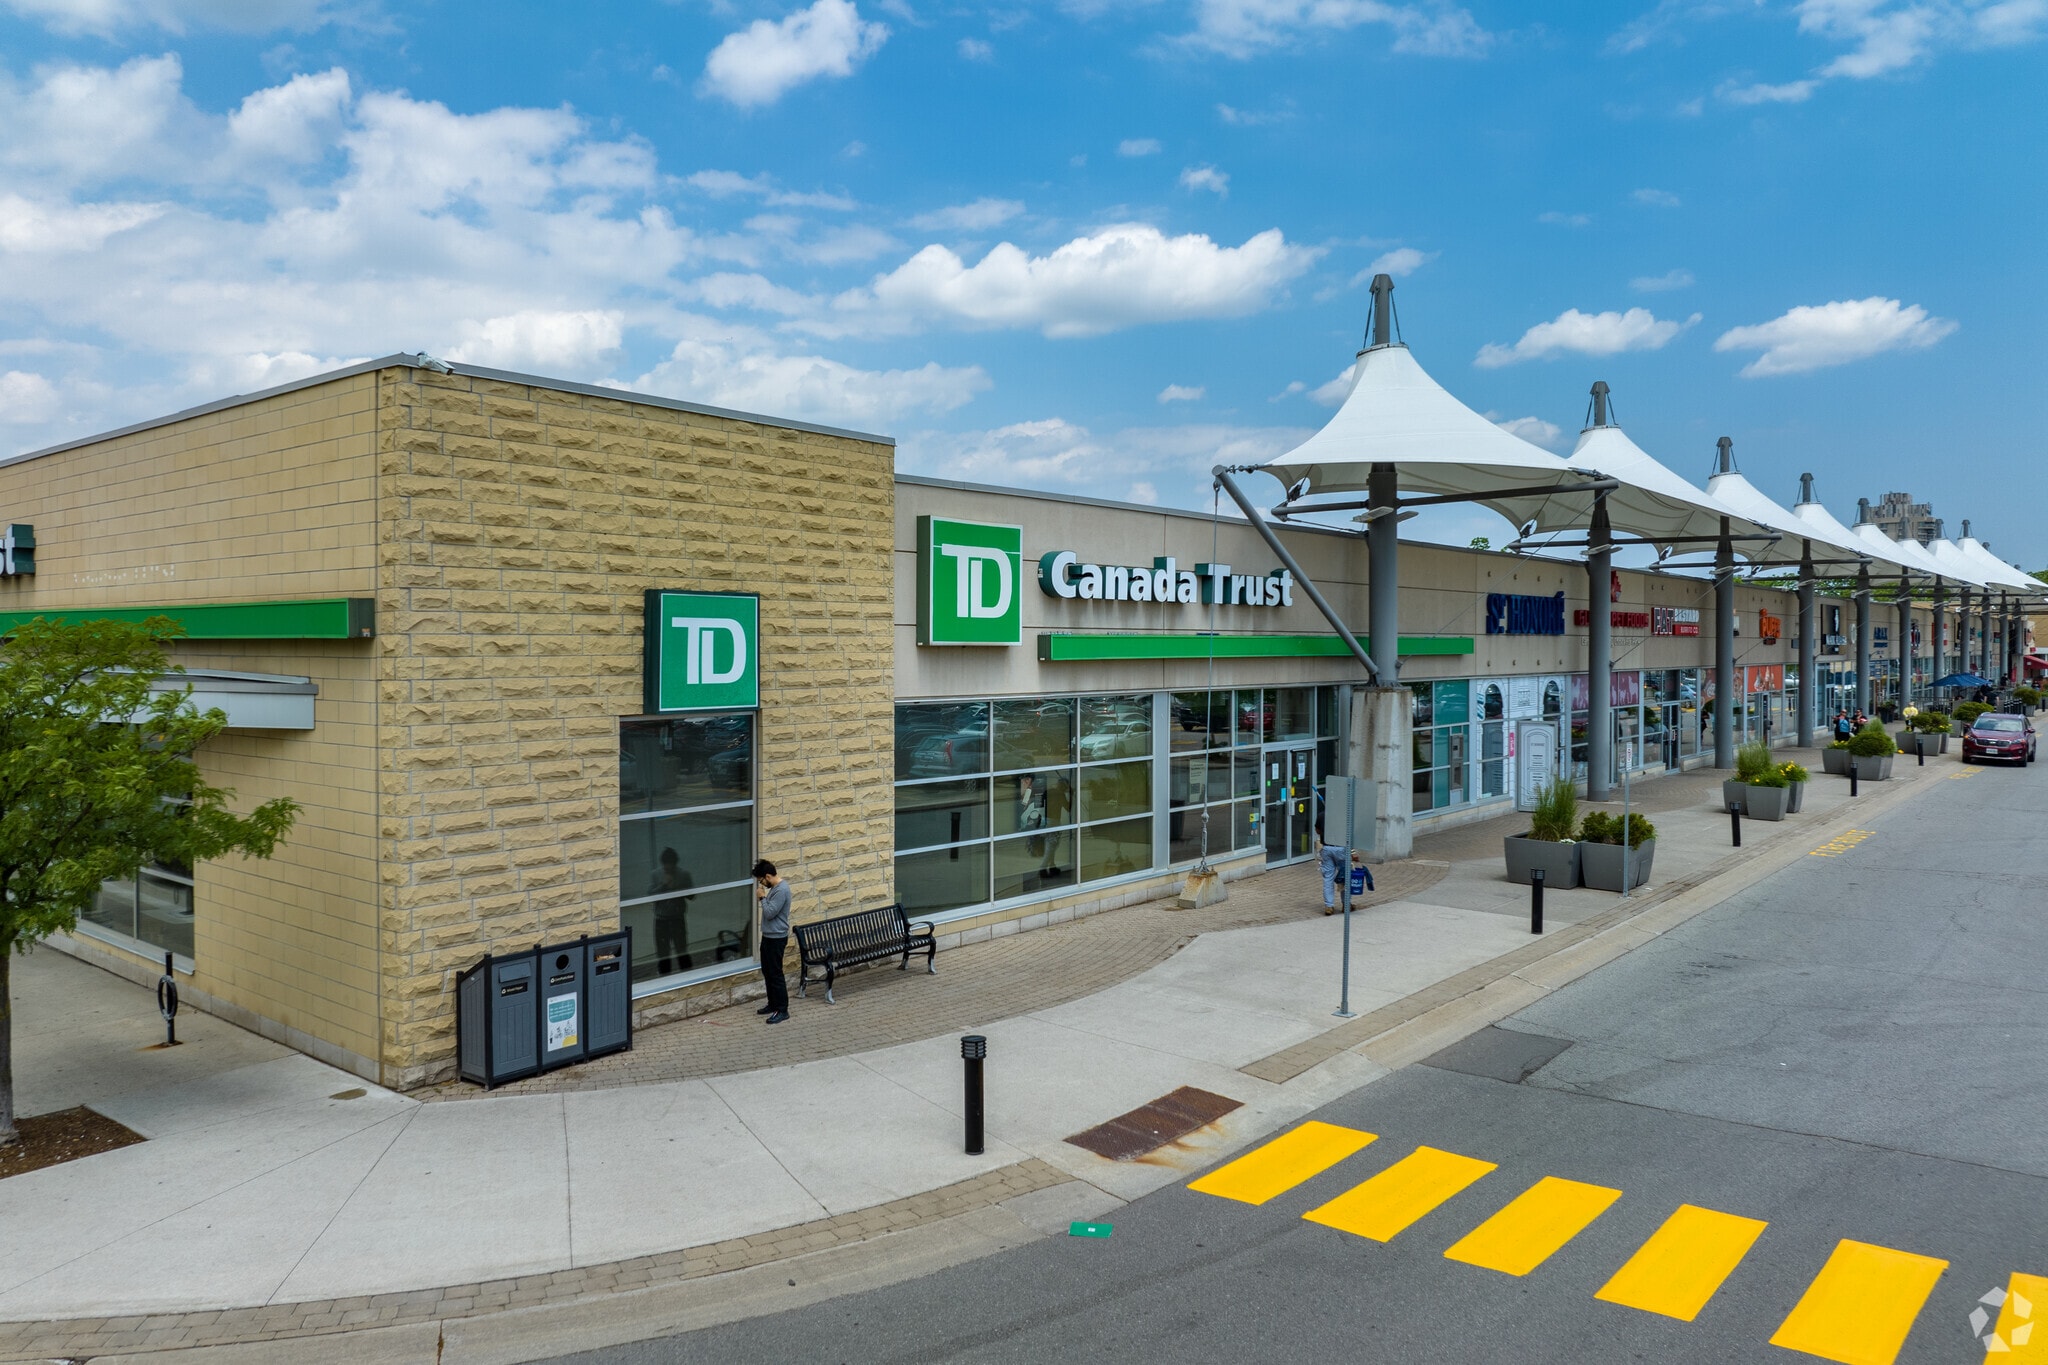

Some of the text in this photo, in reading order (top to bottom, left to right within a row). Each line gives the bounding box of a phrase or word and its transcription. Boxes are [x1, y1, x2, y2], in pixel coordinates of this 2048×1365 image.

[941, 543, 1013, 619] TD
[1049, 550, 1294, 607] Canada Trust
[671, 617, 747, 685] TD
[1653, 607, 1674, 634] FAT
